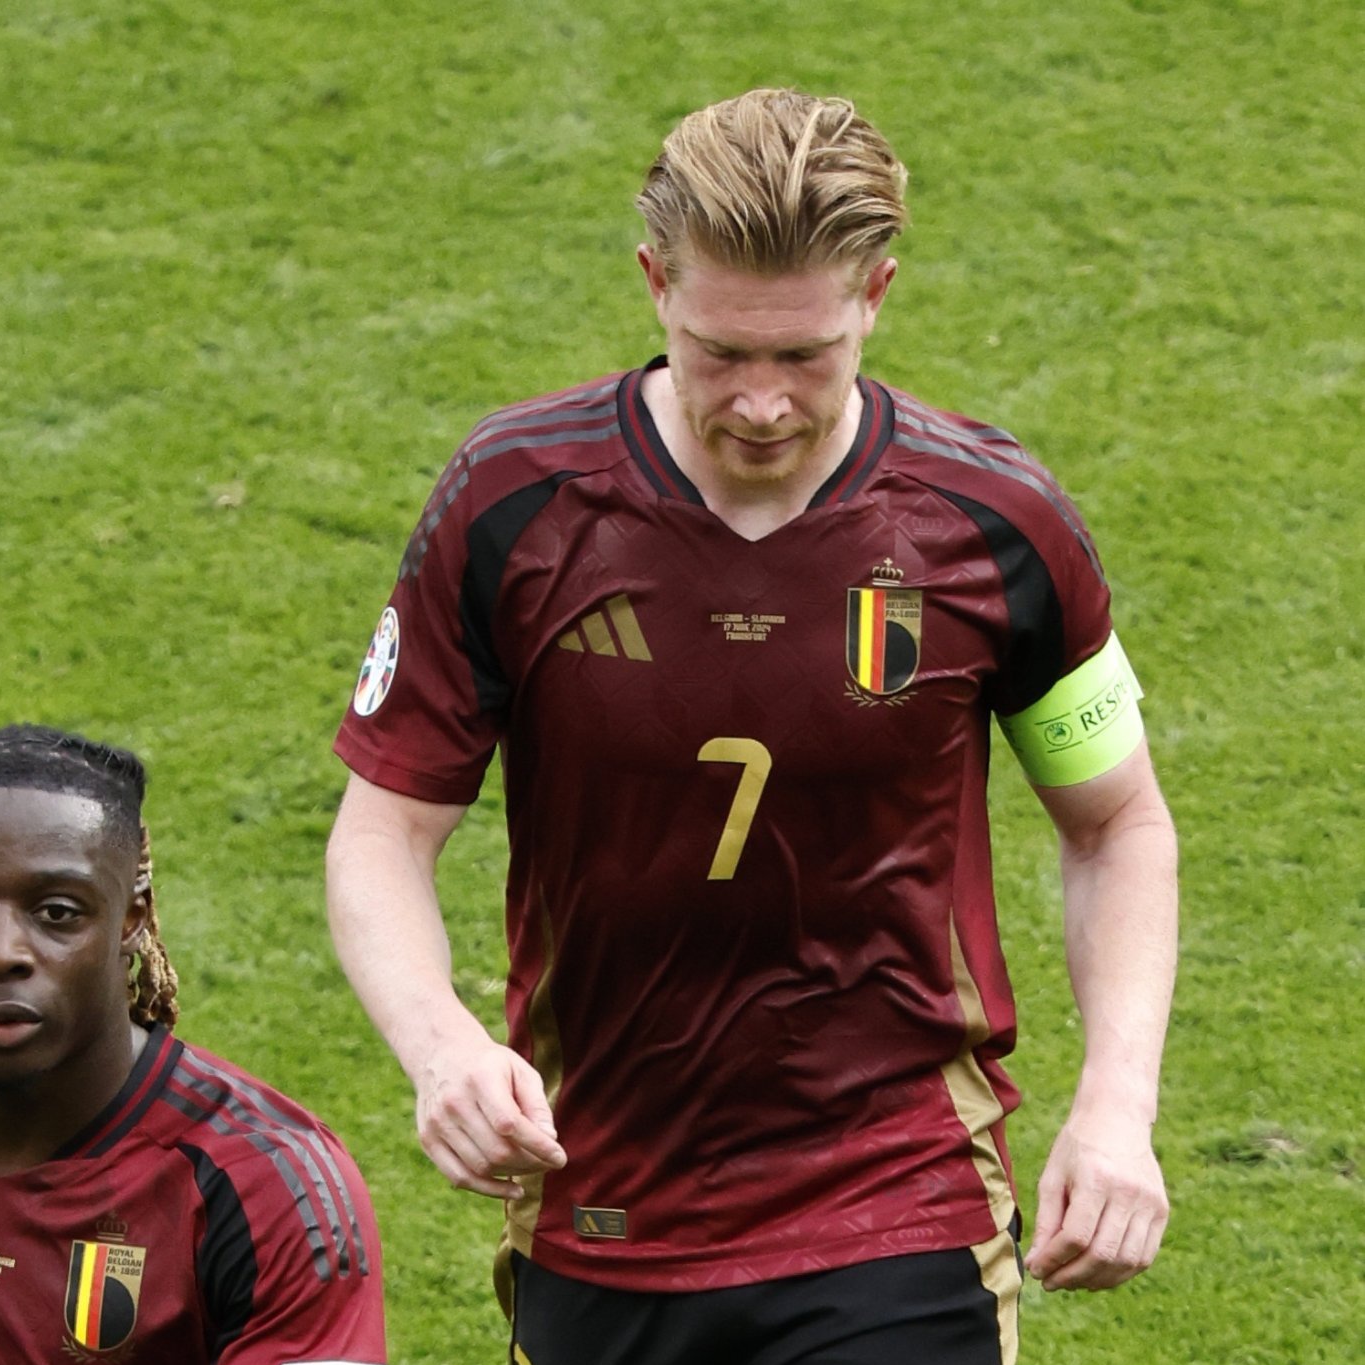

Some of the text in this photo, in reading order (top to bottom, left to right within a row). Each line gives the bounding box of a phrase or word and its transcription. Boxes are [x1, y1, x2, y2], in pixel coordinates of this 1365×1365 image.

[697, 736, 773, 880] 7
[109, 1248, 134, 1258] ROYAL
[107, 1256, 142, 1267] BELGIAN
